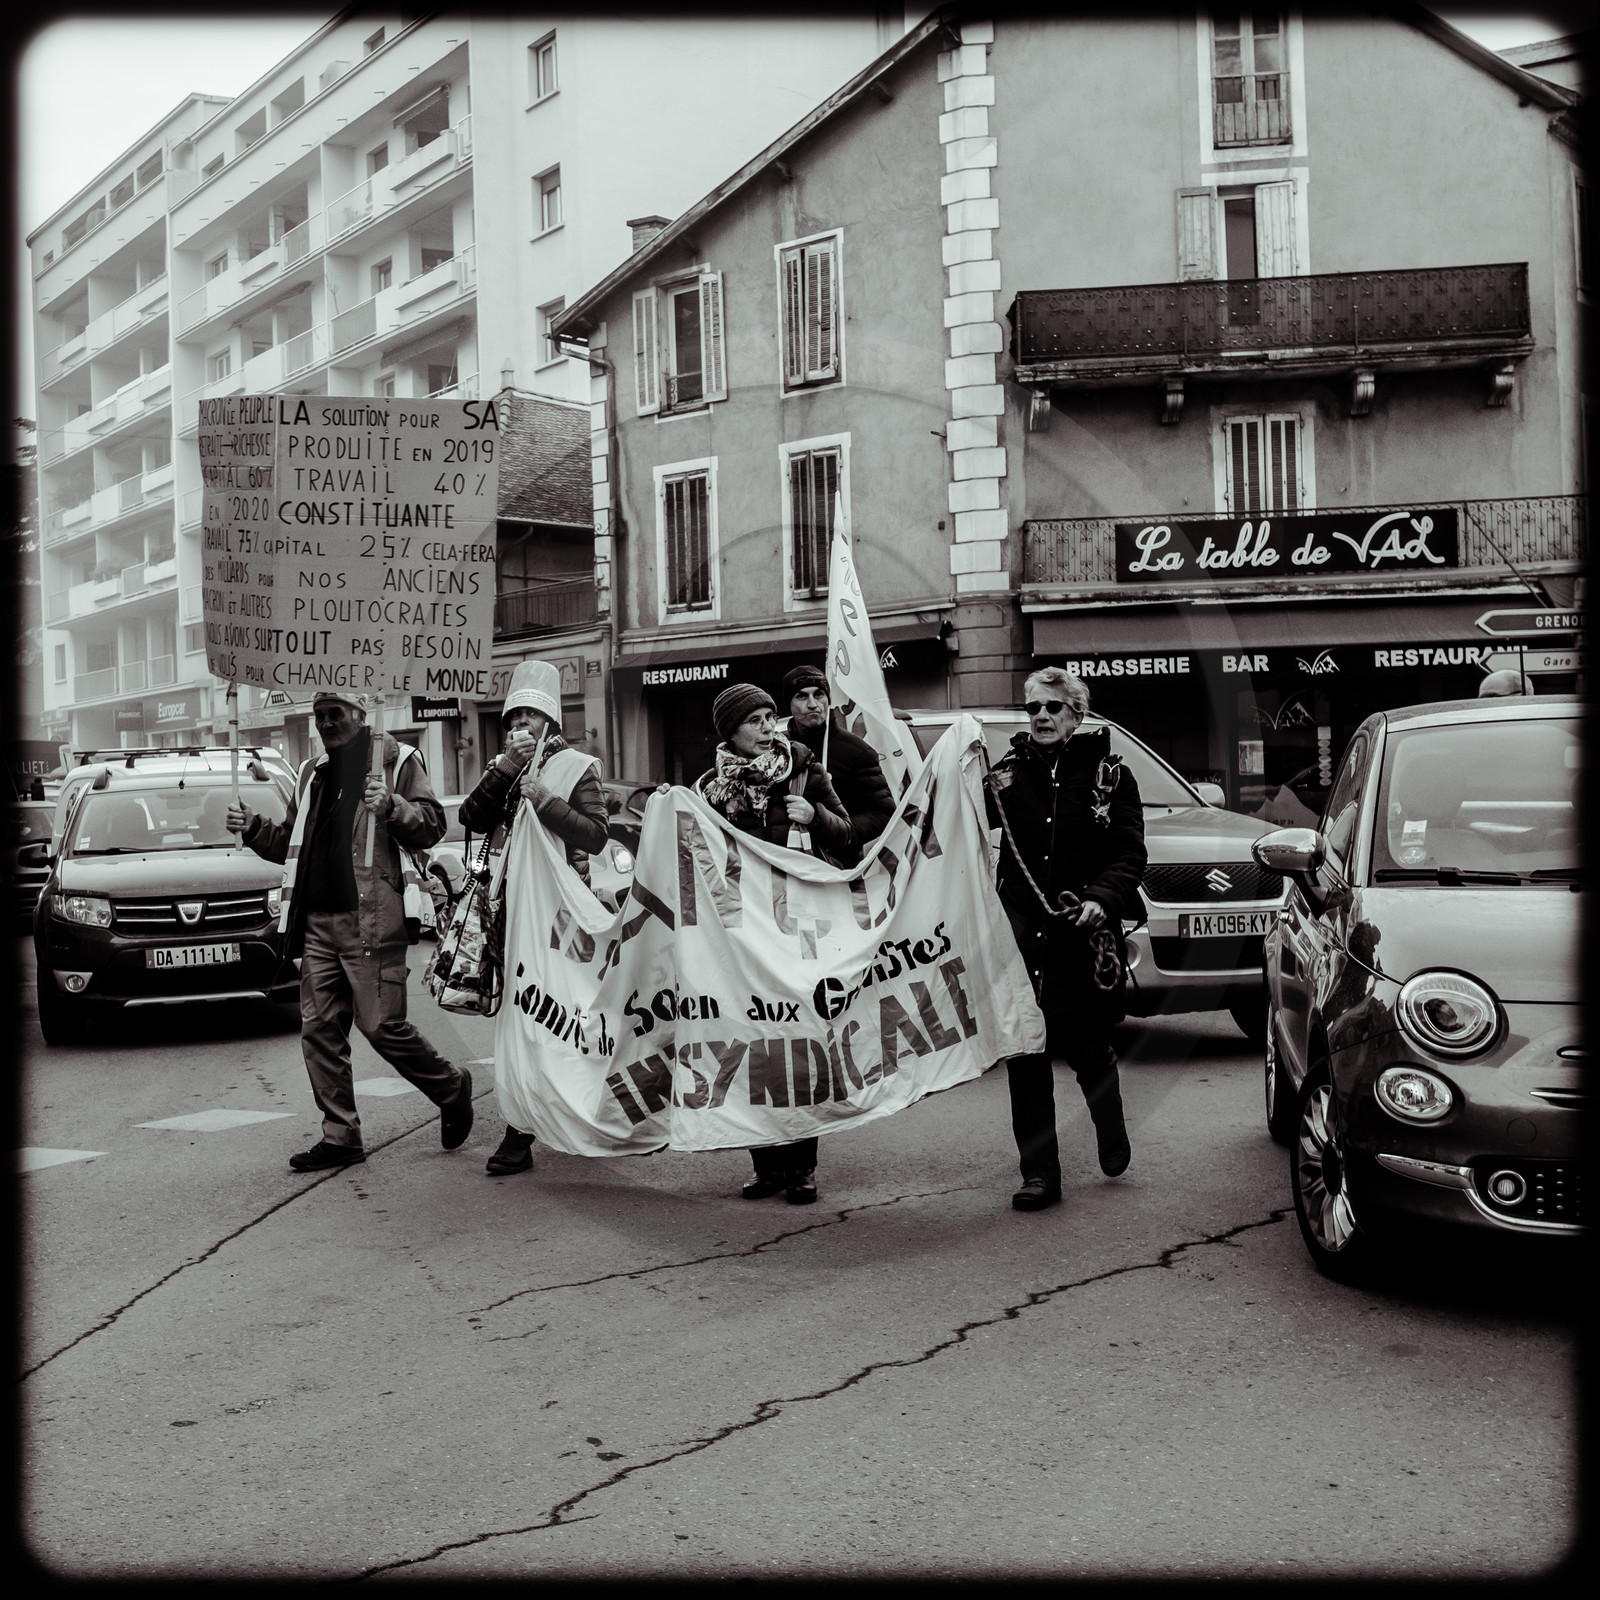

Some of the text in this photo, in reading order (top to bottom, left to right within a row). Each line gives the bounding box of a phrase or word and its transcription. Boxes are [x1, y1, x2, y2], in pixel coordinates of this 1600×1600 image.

[240, 396, 274, 424] PEUPLE
[280, 400, 311, 426] LA
[400, 413, 440, 428] POUR
[462, 400, 500, 431] SA
[412, 447, 432, 462] EN
[443, 439, 494, 463] 2019
[233, 496, 269, 521] 2020
[238, 529, 259, 553] 75%
[360, 535, 411, 558] 25%
[1129, 526, 1184, 573] La
[1195, 520, 1280, 569] table
[1291, 533, 1331, 565] de
[299, 571, 346, 588] NOS
[241, 593, 272, 619] AUTRES
[294, 598, 467, 627] PLOUTOCRATES
[254, 627, 332, 656] SURTOUT
[351, 638, 384, 656] PAS
[1066, 656, 1190, 677] BRASSERIE
[1222, 654, 1270, 673] BAR
[1543, 656, 1571, 667] Gare
[246, 665, 264, 682] POUR
[272, 662, 375, 687] CHANGER
[393, 675, 411, 691] LE
[426, 667, 488, 694] MONDE
[642, 664, 730, 685] RESTAURANT
[158, 702, 186, 719] Europcar
[423, 708, 459, 718] EMPORTER
[746, 994, 800, 1022] aux
